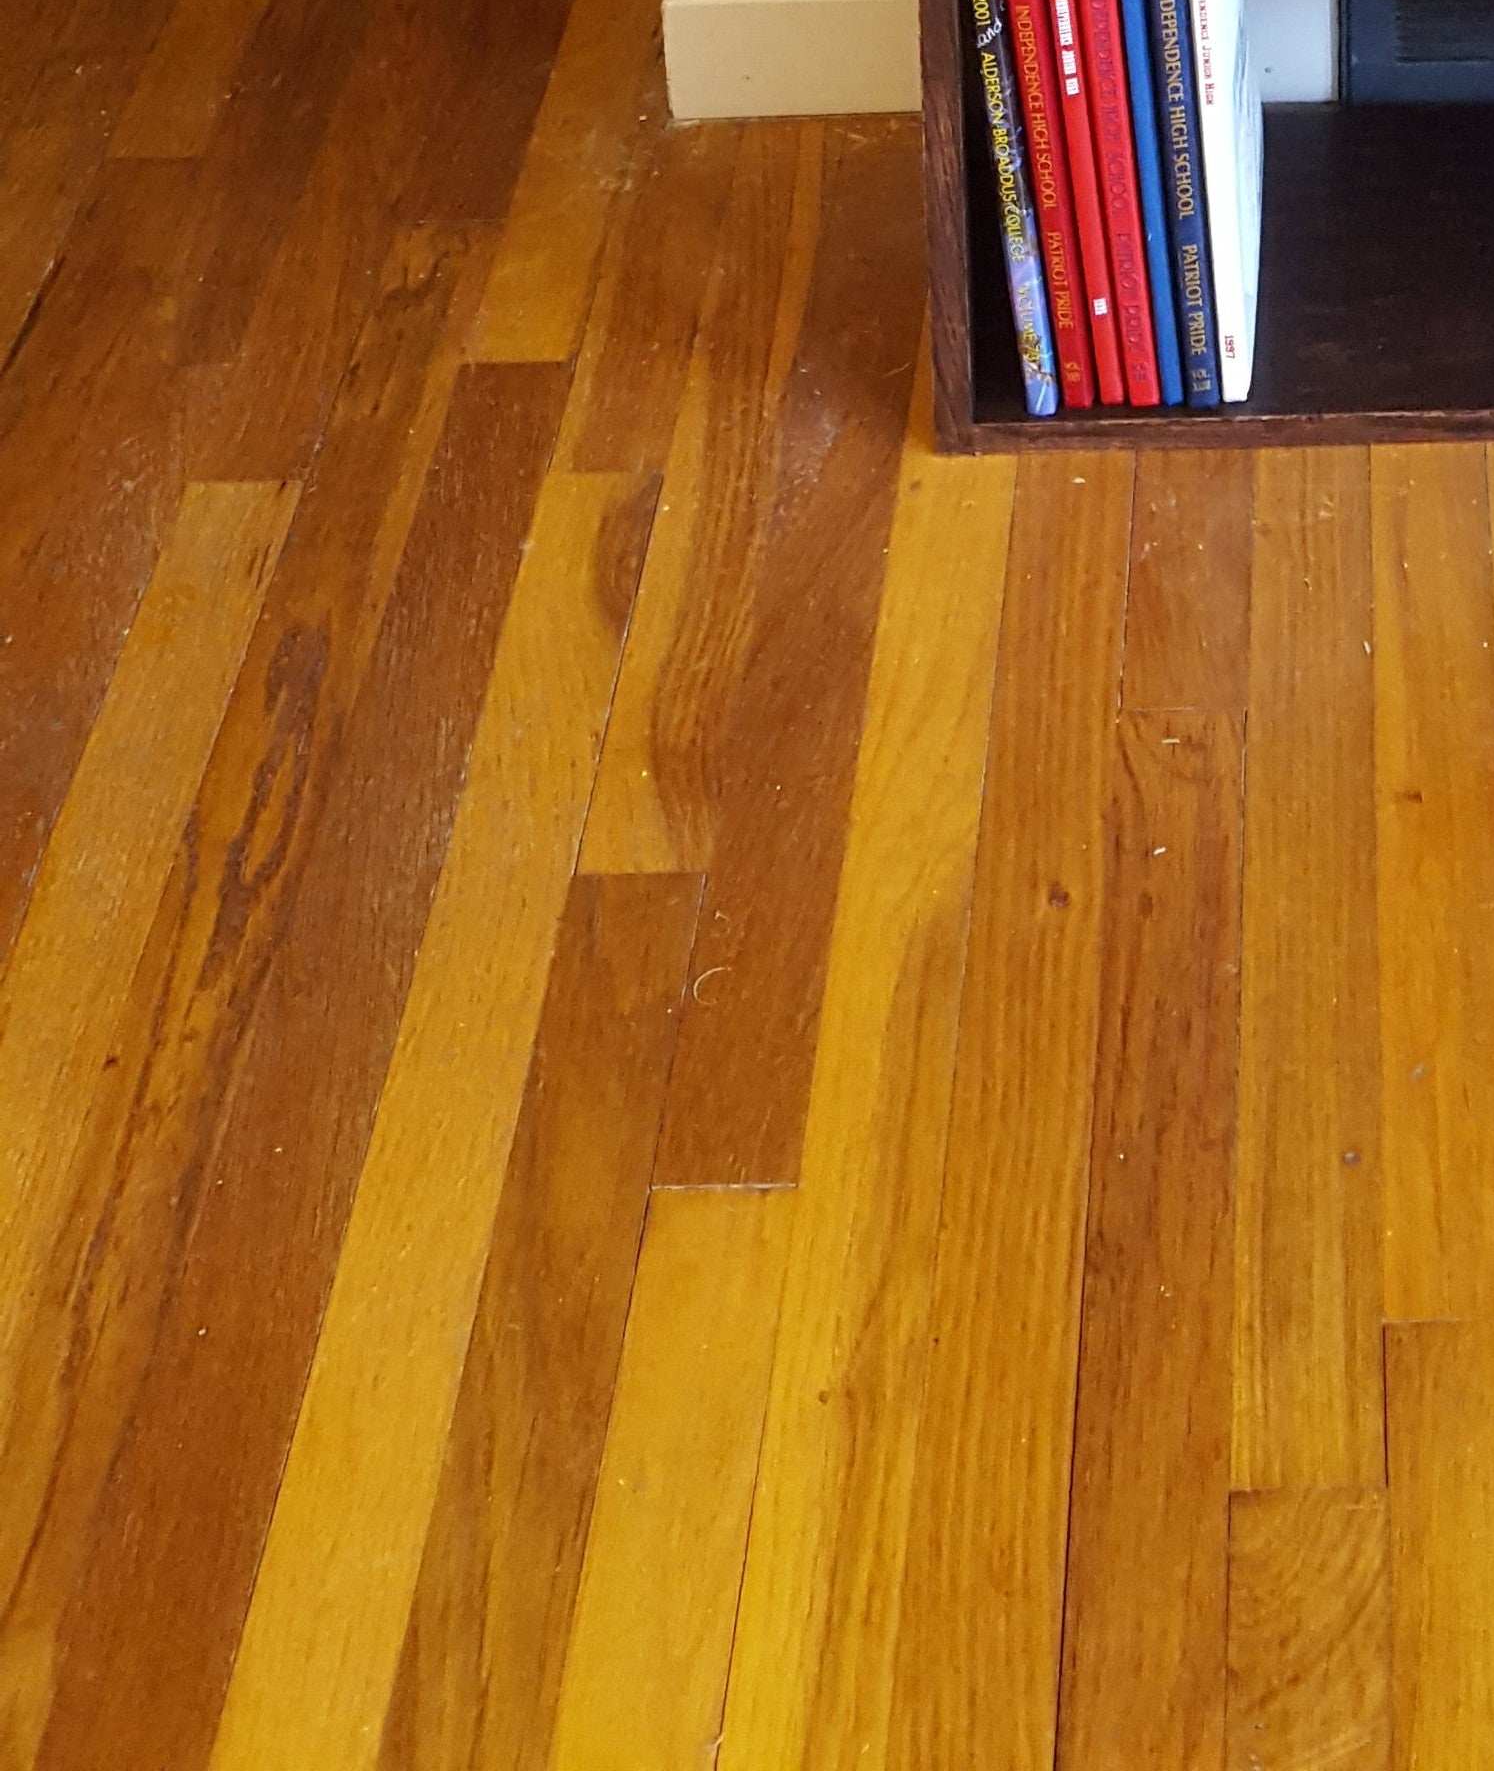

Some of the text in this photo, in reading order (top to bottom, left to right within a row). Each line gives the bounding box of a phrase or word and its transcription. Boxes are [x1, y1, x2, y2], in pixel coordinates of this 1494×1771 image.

[1202, 46, 1215, 80] JUNIOR
[1205, 83, 1215, 106] HIGH
[1171, 106, 1189, 149] HIGH
[1015, 5, 1074, 330] INDEPENDENCE HIGH SCHOOL PATRIOT PRIDE
[1173, 152, 1195, 220] SCHOOL
[1004, 203, 1025, 263] COLLEGE
[1017, 284, 1038, 341] VOLUME
[1182, 244, 1203, 307] PATRIOT
[1188, 311, 1207, 356] PRIDE
